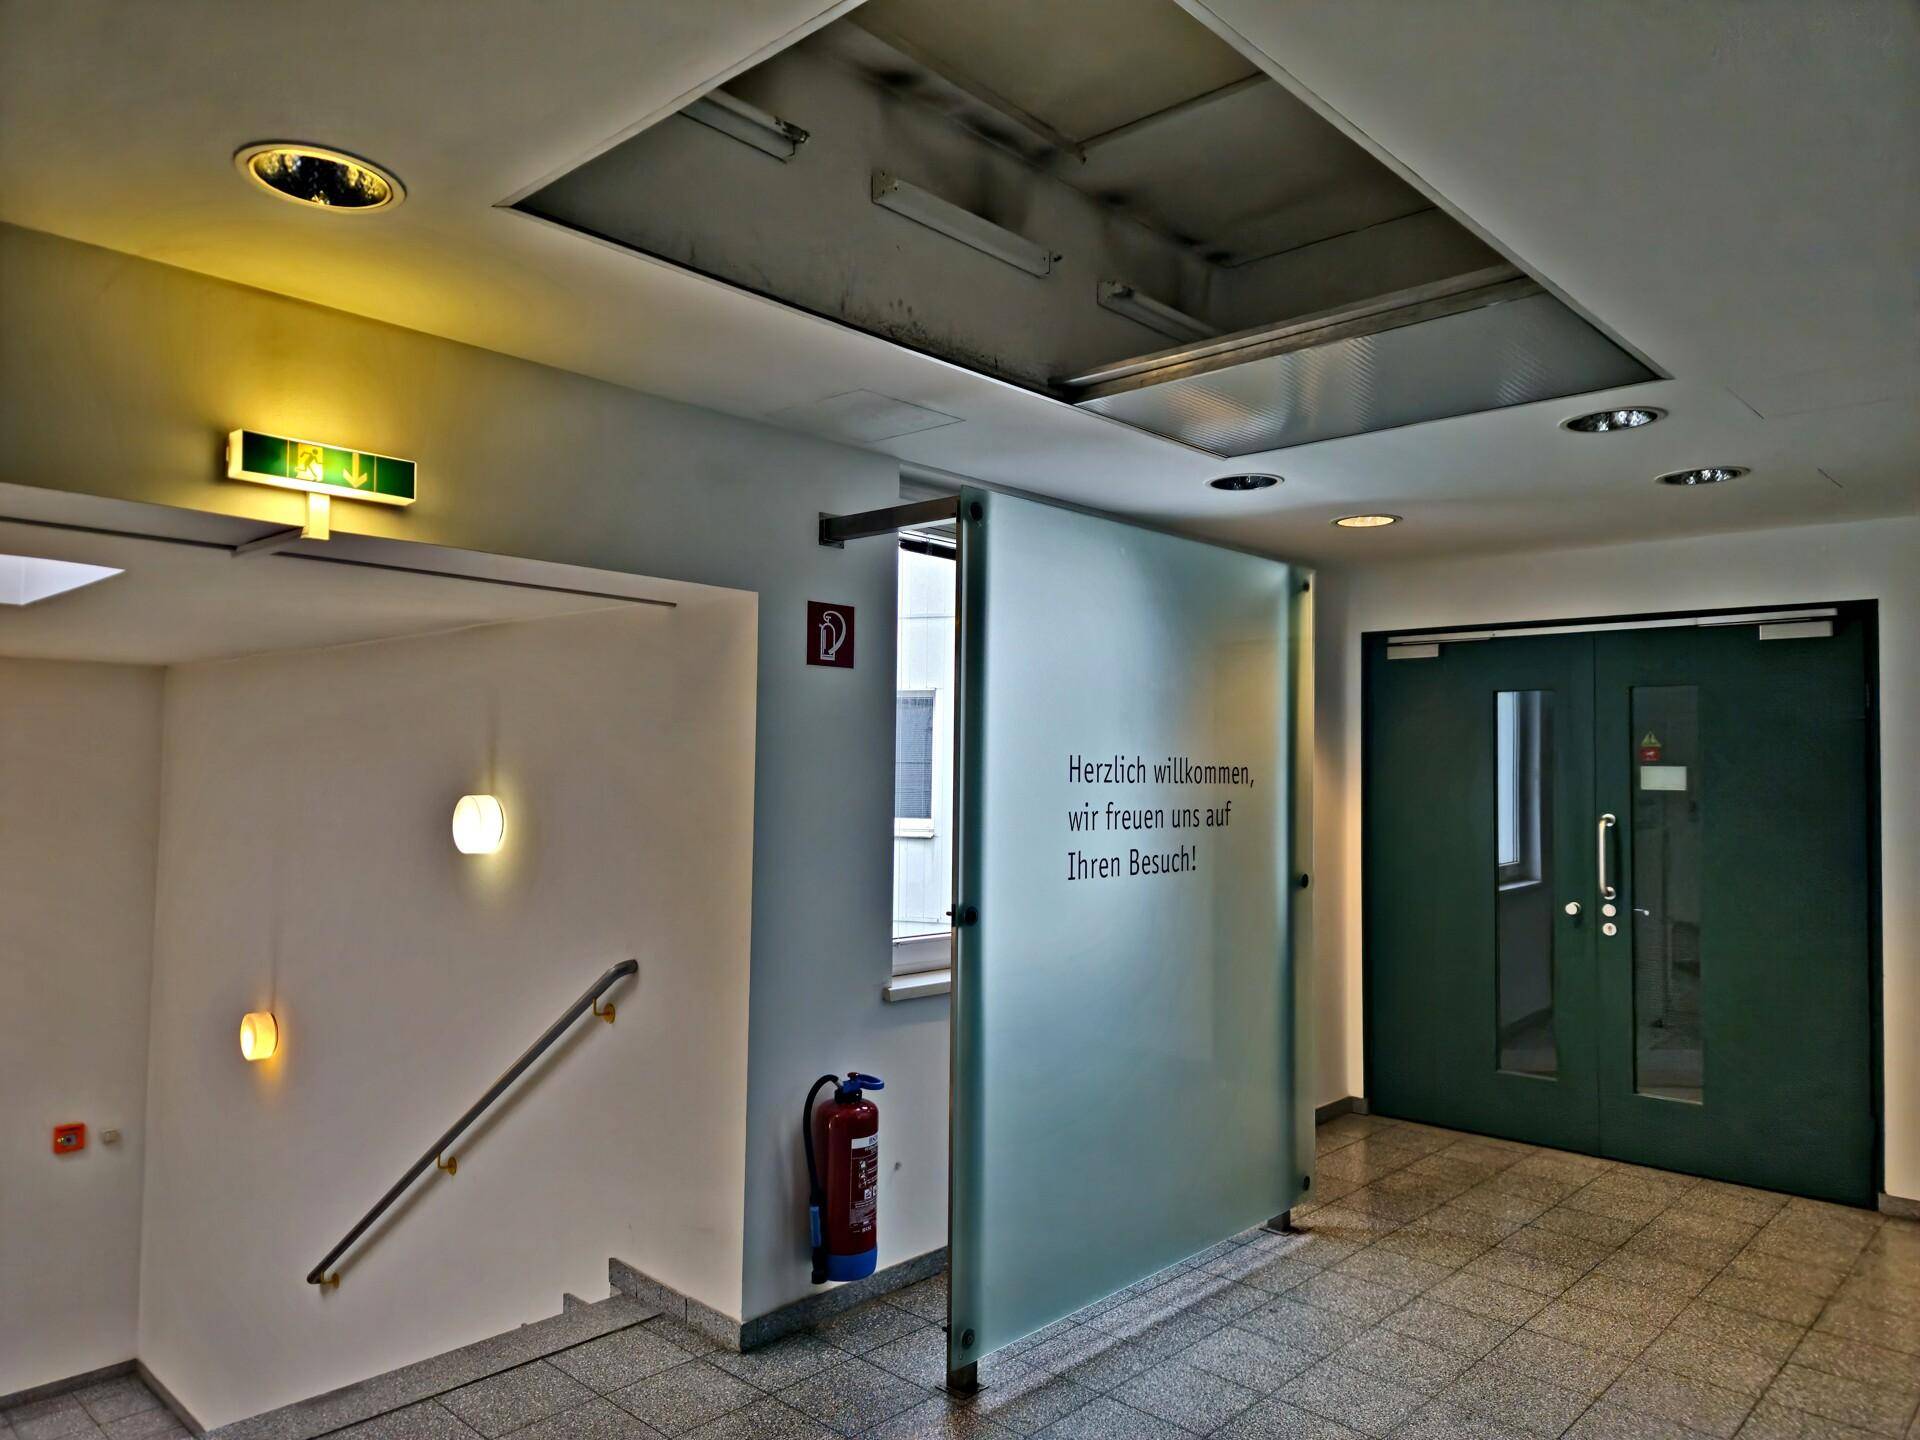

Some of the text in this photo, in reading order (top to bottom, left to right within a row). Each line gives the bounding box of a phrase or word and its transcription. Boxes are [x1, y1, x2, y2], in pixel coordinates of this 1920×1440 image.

[1069, 754, 1254, 788] Herzlich willkommen,
[1068, 800, 1232, 832] wir freuen uns auf
[1067, 845, 1196, 881] Ihren Besuch!
